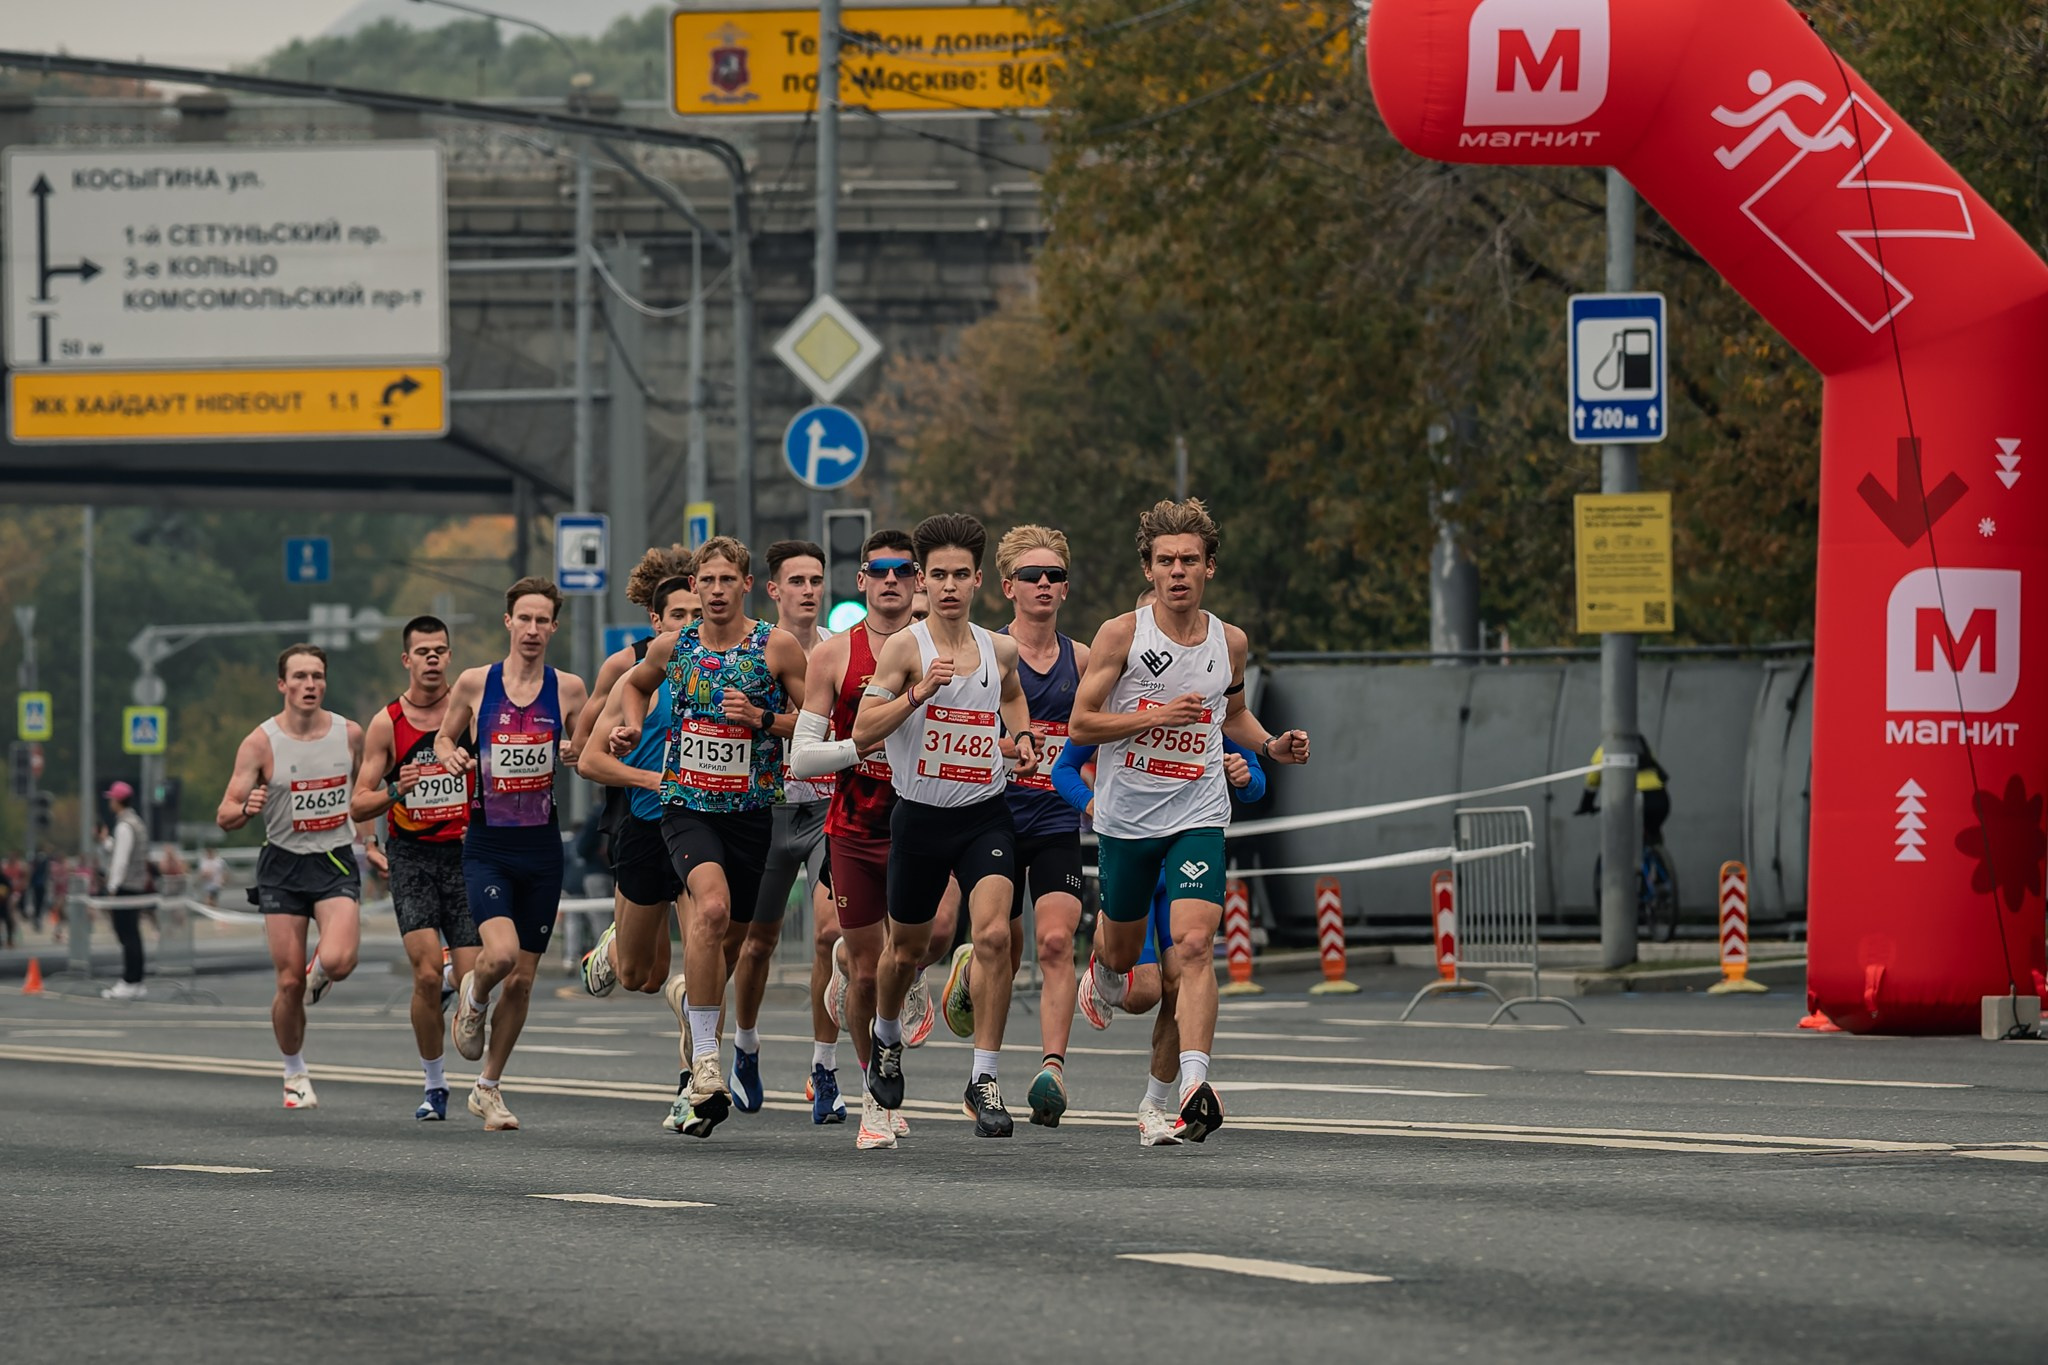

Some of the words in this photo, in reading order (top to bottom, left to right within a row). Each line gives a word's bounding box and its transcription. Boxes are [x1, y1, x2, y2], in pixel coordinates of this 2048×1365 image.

[1496, 29, 1580, 92] М
[861, 66, 987, 92] Москве:
[1458, 131, 1600, 147] магнит
[72, 168, 220, 190] КОСЫГИНА
[227, 170, 263, 194] ул.
[125, 224, 161, 246] 1-й
[168, 218, 341, 246] СЕТУНЬСКИЙ
[348, 226, 386, 246] пр.
[125, 257, 161, 279] 3-е
[168, 254, 278, 279] КОЛЬЦО
[123, 283, 365, 312] КОМСОМОЛЬСКИЙ
[371, 289, 423, 312] пр-т
[195, 391, 304, 414] HIDEOUT
[1915, 607, 1996, 673] М
[924, 730, 994, 758] 31482
[1886, 720, 2019, 746] магнит
[500, 747, 547, 767] 2566
[683, 736, 745, 763] 21531
[509, 767, 540, 775] НИКОЛАЙ
[698, 762, 727, 771] КИРИЛЛ
[294, 788, 346, 811] 26632
